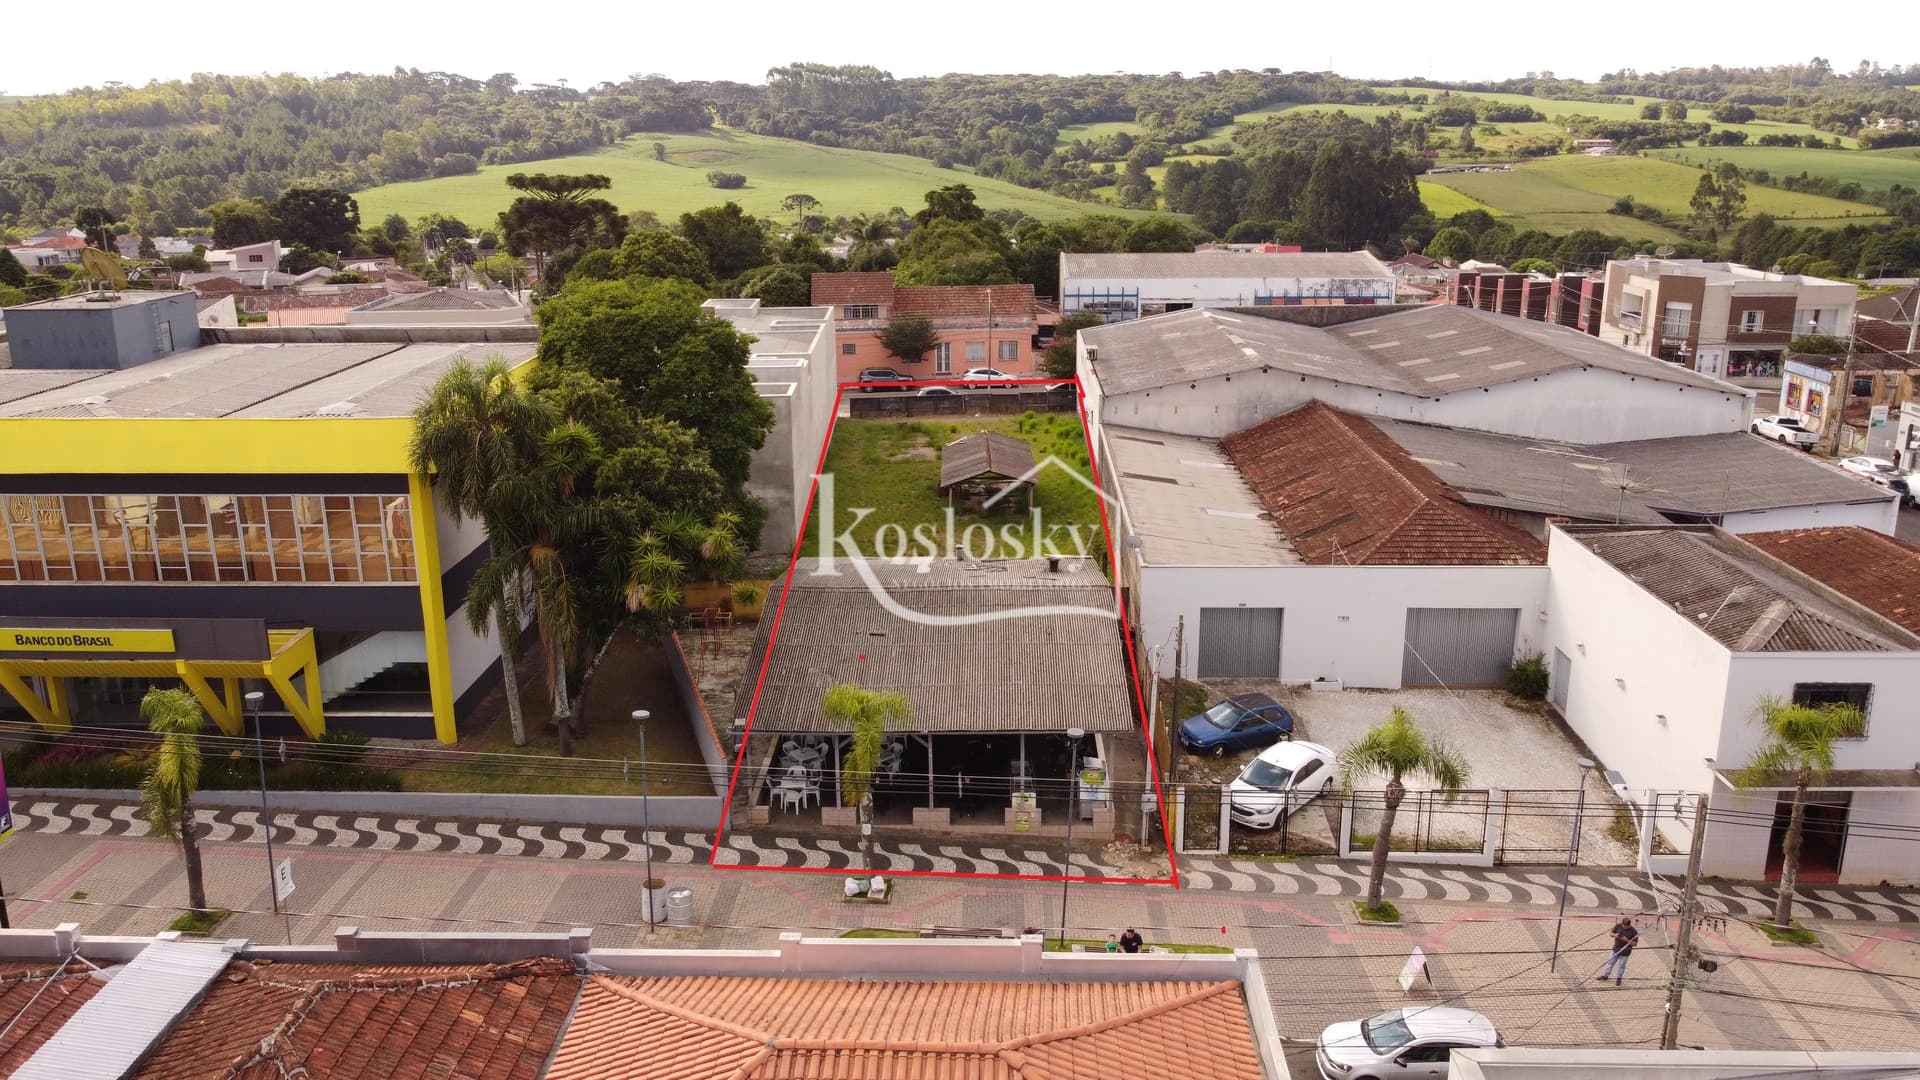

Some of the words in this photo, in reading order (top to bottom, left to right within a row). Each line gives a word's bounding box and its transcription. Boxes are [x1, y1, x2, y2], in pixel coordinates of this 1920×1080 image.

[15, 634, 56, 646] BANCO
[57, 636, 73, 646] DO
[73, 635, 113, 647] BRASIL
[280, 866, 287, 881] E
